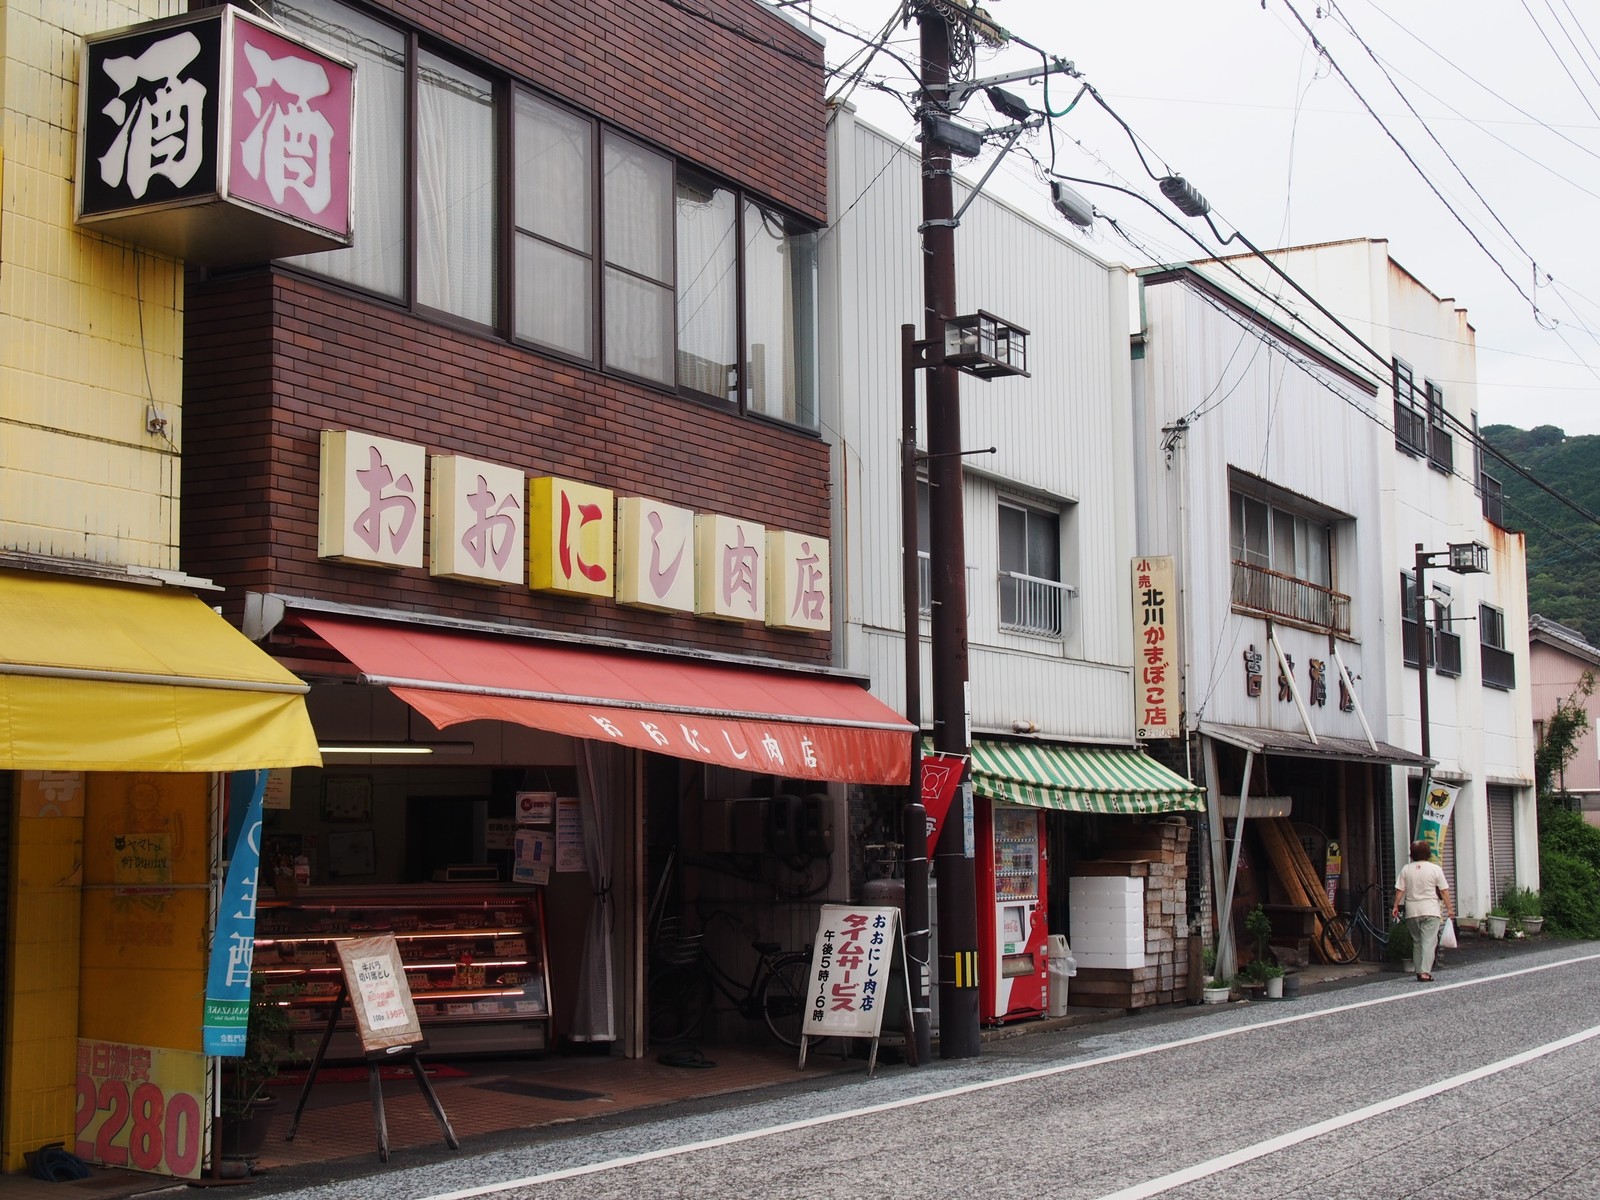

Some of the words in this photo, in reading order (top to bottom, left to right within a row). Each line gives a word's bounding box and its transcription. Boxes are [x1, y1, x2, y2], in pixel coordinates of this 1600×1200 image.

[98, 31, 207, 199] 酒
[241, 41, 335, 214] 酒
[352, 446, 826, 621] おおにし肉店
[1137, 559, 1152, 588] 小売
[1142, 588, 1169, 726] 北川かまぼこ店
[589, 714, 818, 768] おおにし肉店
[830, 914, 869, 1012] タイムサービス
[859, 915, 886, 1011] おおにし肉店
[75, 1073, 200, 1176] 2280
